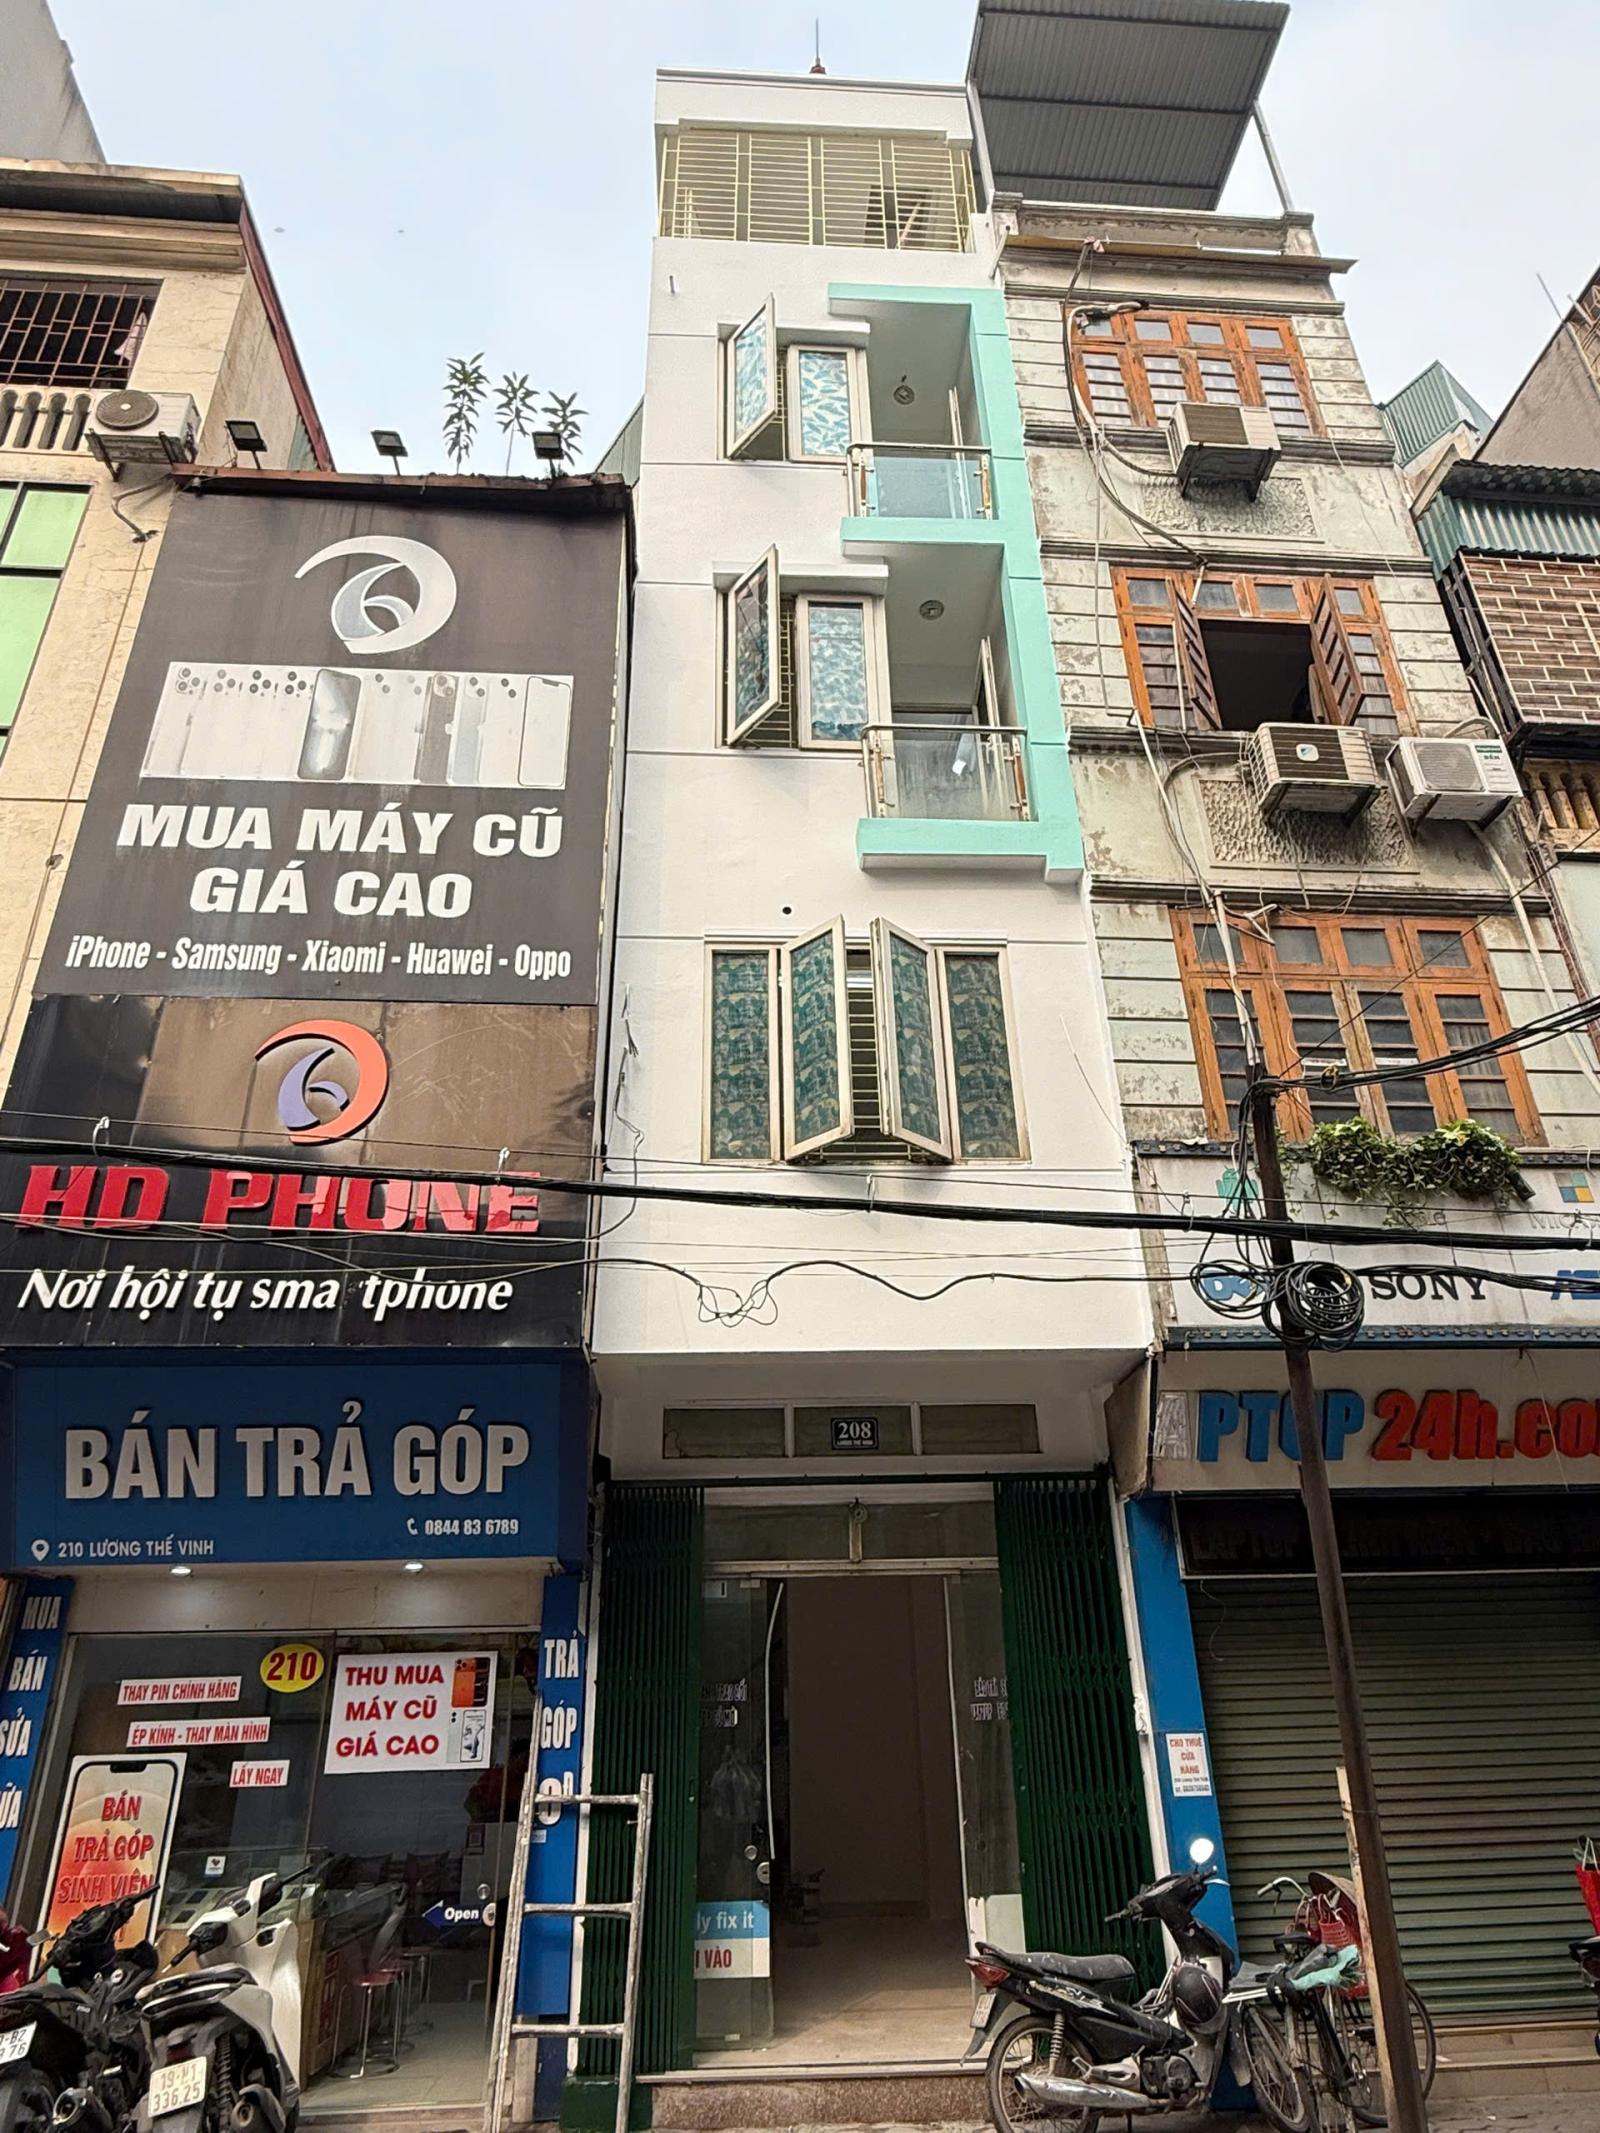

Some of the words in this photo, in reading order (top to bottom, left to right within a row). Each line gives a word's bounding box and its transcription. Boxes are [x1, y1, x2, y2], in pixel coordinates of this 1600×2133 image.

[116, 803, 273, 851] MUA
[296, 802, 454, 856] MÁY
[473, 807, 564, 857] CŨ
[189, 860, 309, 914] GIÁ
[333, 871, 473, 919] CAO
[65, 935, 152, 970] iPhone
[171, 936, 281, 976] Samsung
[302, 940, 388, 974] Xiaomi
[406, 942, 494, 976] Huawei
[514, 943, 571, 981] Oppo
[15, 1165, 169, 1231] HD
[200, 1169, 541, 1234] PHONE
[18, 1269, 107, 1310] Nơi
[109, 1265, 182, 1321] hội
[193, 1272, 237, 1322] tụ
[1368, 1273, 1486, 1301] SONY
[838, 1421, 871, 1439] 208
[1371, 1388, 1600, 1461] 24h.co
[64, 1409, 217, 1500] BÁN
[235, 1400, 372, 1498] TRẢ
[392, 1409, 529, 1496] GÓP
[425, 1519, 461, 1536] 0844
[463, 1519, 481, 1536] 83
[484, 1519, 519, 1536] 6789
[58, 1541, 83, 1558] 210
[89, 1539, 141, 1558] LƯƠNG
[146, 1534, 174, 1556] THẾ
[178, 1540, 214, 1556] VINH
[21, 1596, 61, 1630] MUA
[266, 1651, 317, 1681] 210
[544, 1630, 579, 1679] TRẢ
[8, 1649, 47, 1692] BÁN
[345, 1666, 388, 1686] THU
[395, 1665, 444, 1685] MUA
[123, 1685, 149, 1702] THAY
[150, 1684, 171, 1700] PIN
[172, 1680, 206, 1700] CHÍNH
[207, 1679, 237, 1698] HÀNG
[345, 1696, 397, 1721] MÁY
[403, 1695, 437, 1719] CŨ
[131, 1725, 147, 1745] ÉP
[148, 1724, 176, 1744] KÍNH
[186, 1727, 210, 1743] THAY
[213, 1722, 240, 1742] MÀN
[241, 1721, 268, 1741] HÌNH
[540, 1700, 577, 1749] GÓP
[336, 1731, 378, 1757] GIÁ
[385, 1734, 439, 1757] CAO
[232, 1762, 253, 1785] LẤY
[255, 1767, 284, 1784] NGAY
[101, 1790, 142, 1821] BÁN
[74, 1829, 109, 1863] TRẢ
[113, 1829, 155, 1861] GÓP
[57, 1874, 107, 1904] SINH
[444, 1907, 480, 1923] Open
[716, 1911, 738, 1929] fix
[743, 1910, 755, 1929] it
[704, 1945, 732, 1969] VÀO
